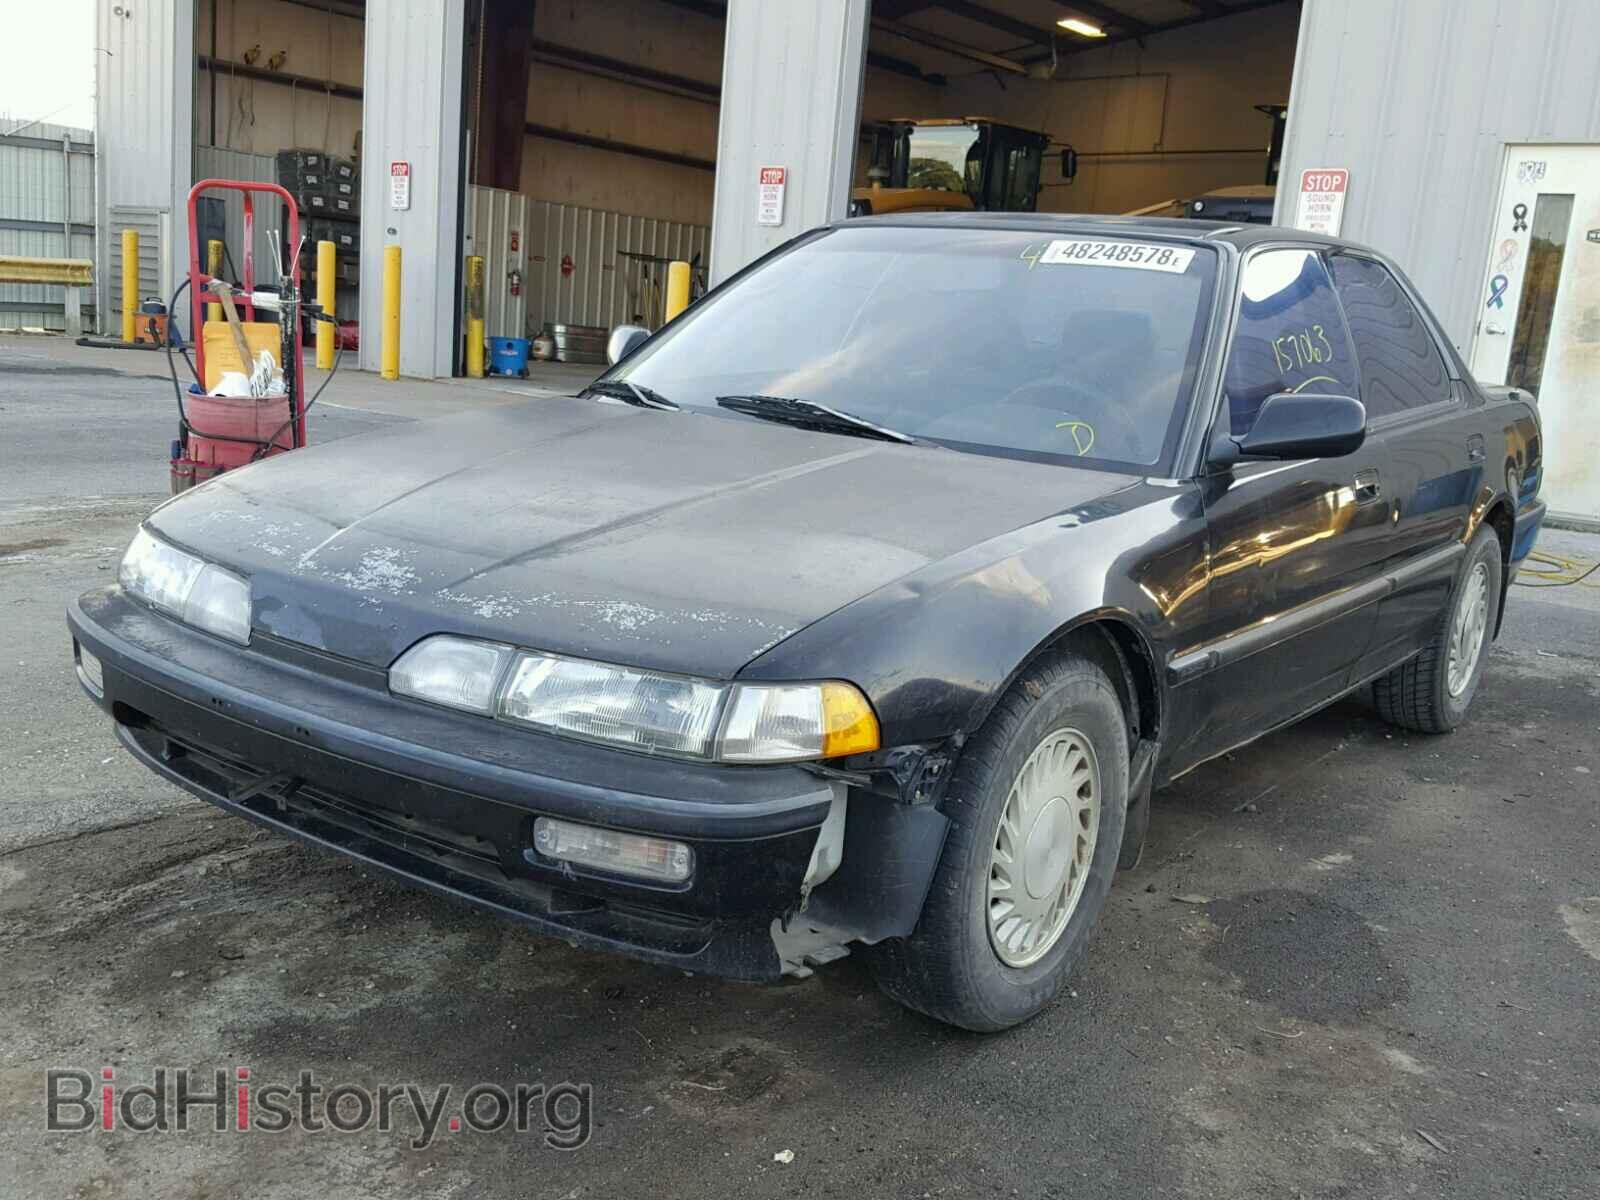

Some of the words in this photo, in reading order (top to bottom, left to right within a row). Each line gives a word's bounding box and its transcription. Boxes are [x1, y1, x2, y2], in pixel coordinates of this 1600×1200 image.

[762, 170, 783, 184] STOP
[1305, 174, 1342, 191] STOP
[1062, 242, 1174, 266] 48248578
